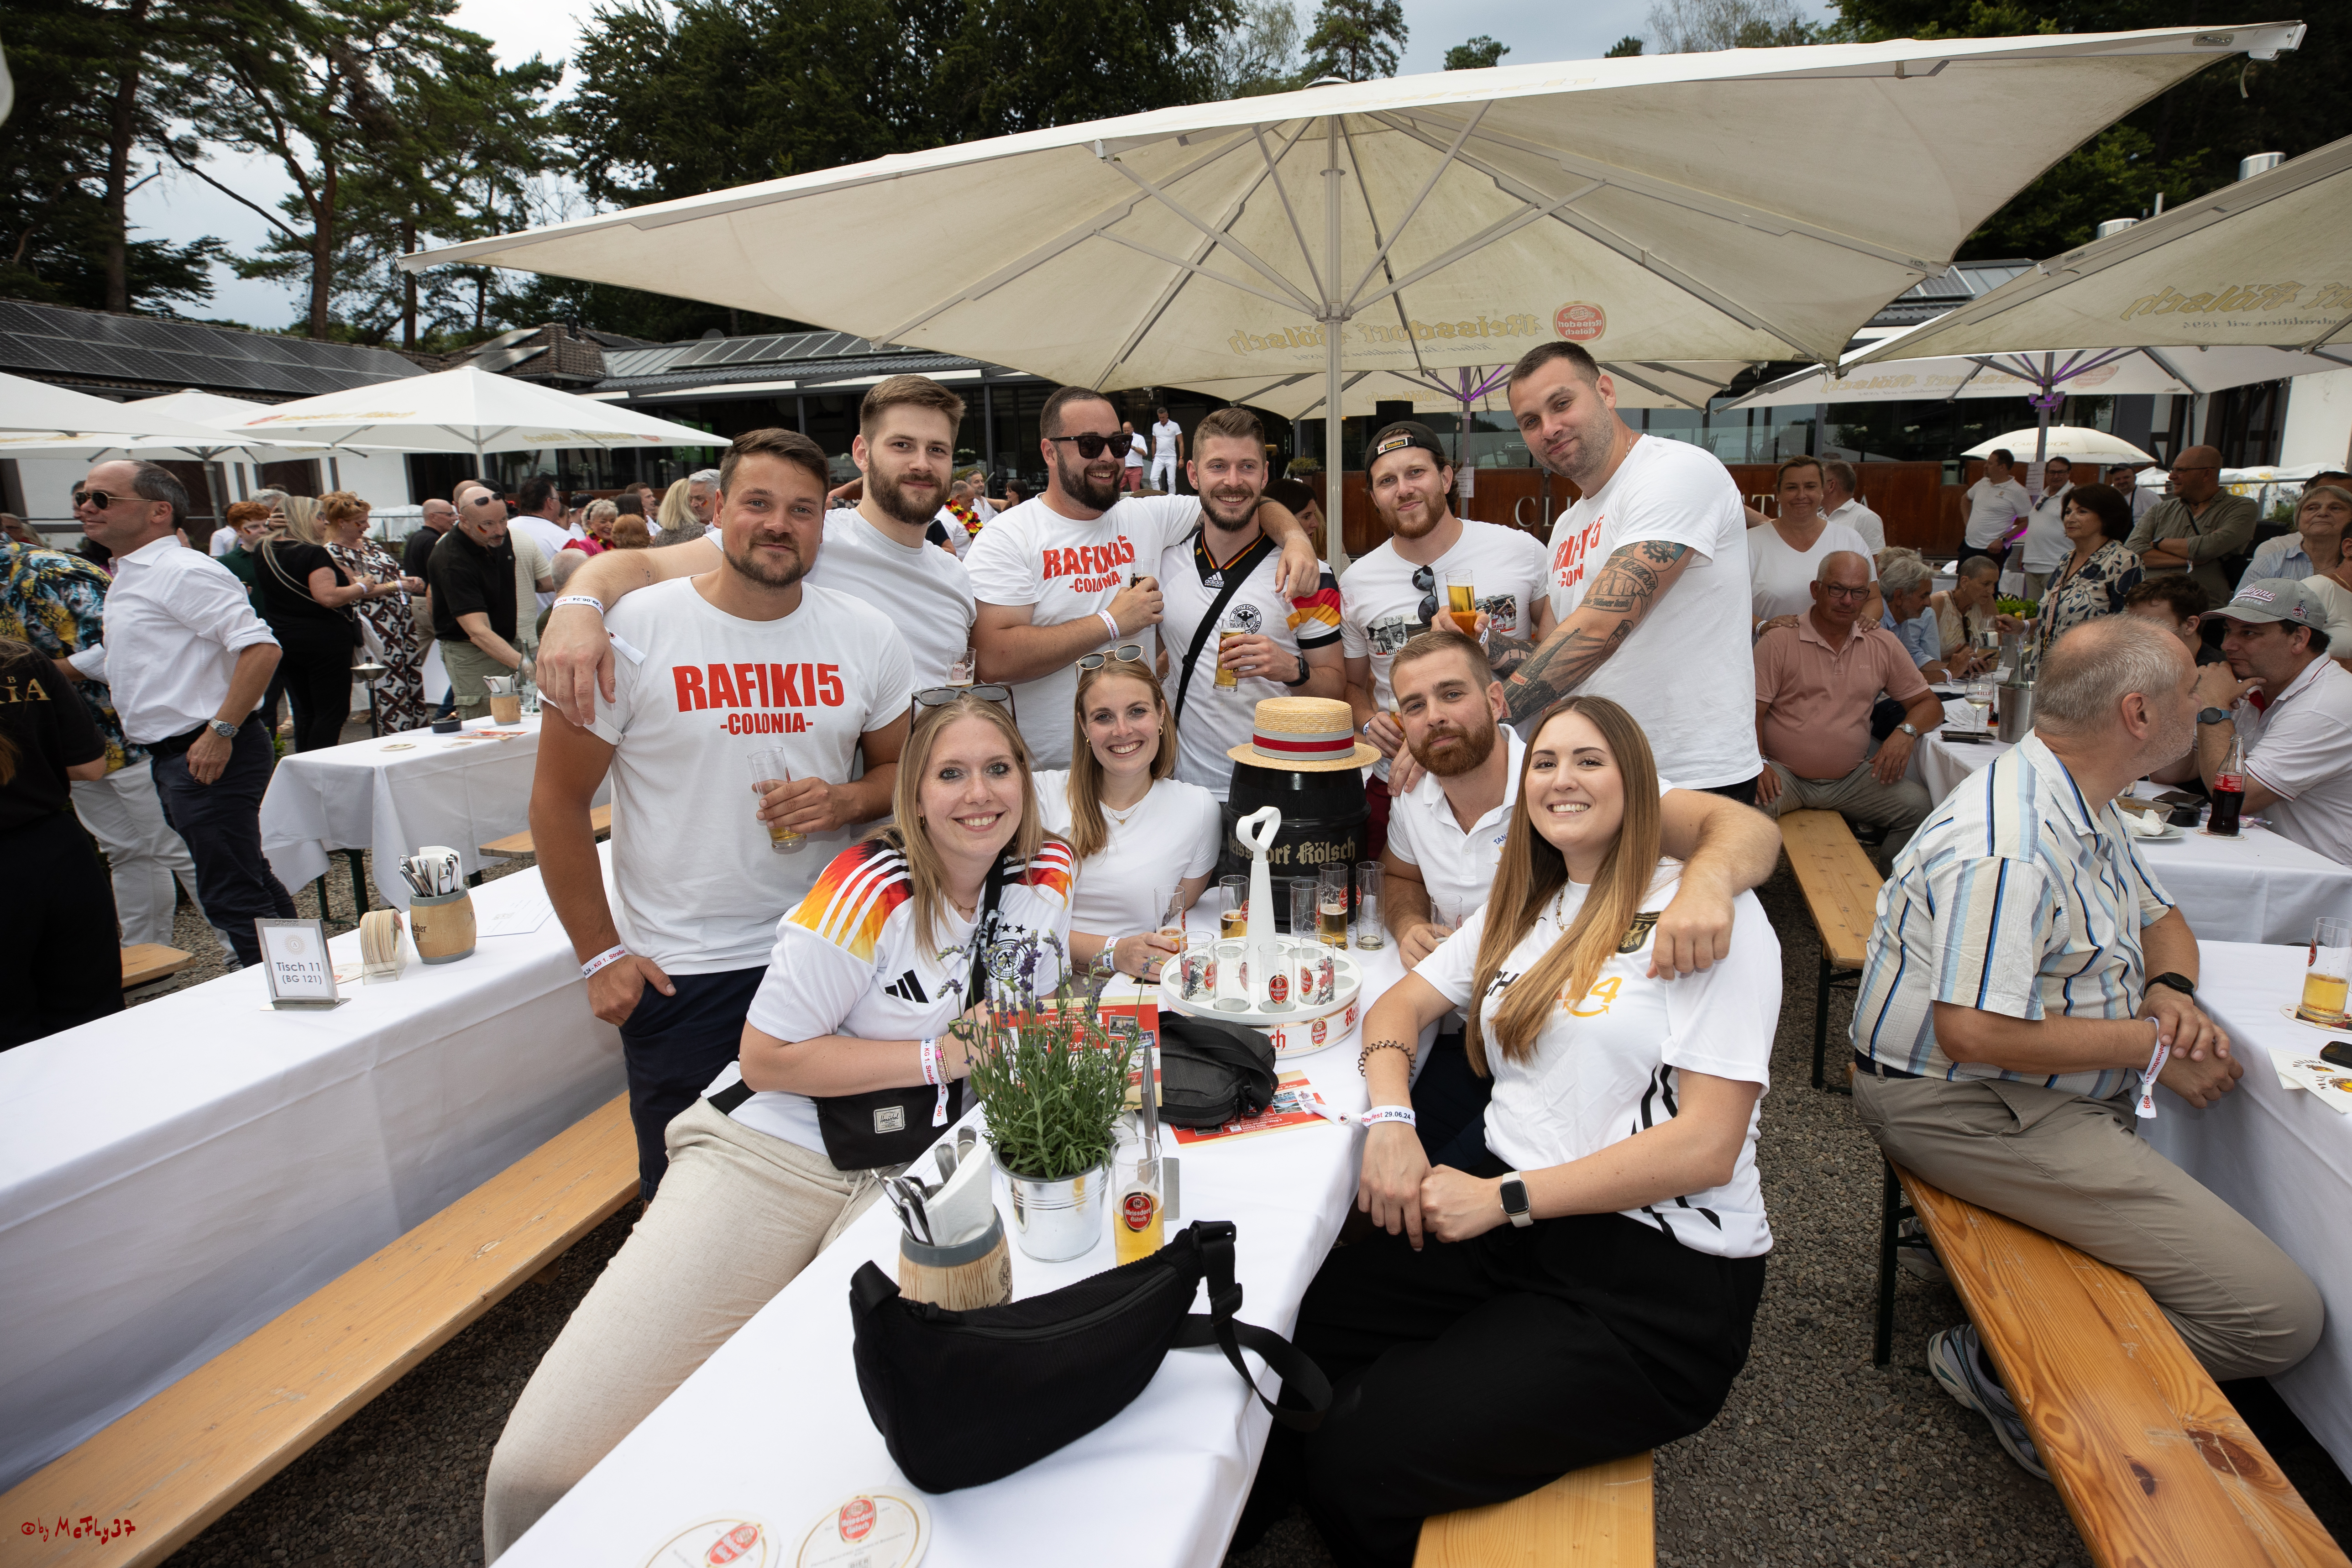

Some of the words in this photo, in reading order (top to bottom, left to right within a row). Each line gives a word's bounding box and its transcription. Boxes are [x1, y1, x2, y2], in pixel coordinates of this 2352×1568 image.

[1386, 441, 1404, 449] Steelers
[1069, 571, 1122, 593] -COLONA-
[572, 597, 599, 606] 29.06.24
[1232, 605, 1259, 616] DEUTSCHER
[0, 678, 51, 704] IA
[672, 663, 844, 713] RAFIKI5
[720, 713, 813, 735] -COLONIA-
[1228, 832, 1291, 865] Reissorf
[1296, 835, 1356, 865] Kölsch
[276, 962, 305, 971] Tisch
[309, 962, 321, 972] 11
[593, 960, 602, 969] KG
[283, 975, 299, 984] (BG
[303, 975, 322, 985] 121)
[924, 1048, 930, 1056] KG
[2292, 1059, 2326, 1069] MALIBU
[2315, 1075, 2329, 1091] MAL
[880, 1112, 899, 1124] Herschel
[1385, 1111, 1411, 1119] 29.06.24
[1126, 1207, 1150, 1216] Reissdorf
